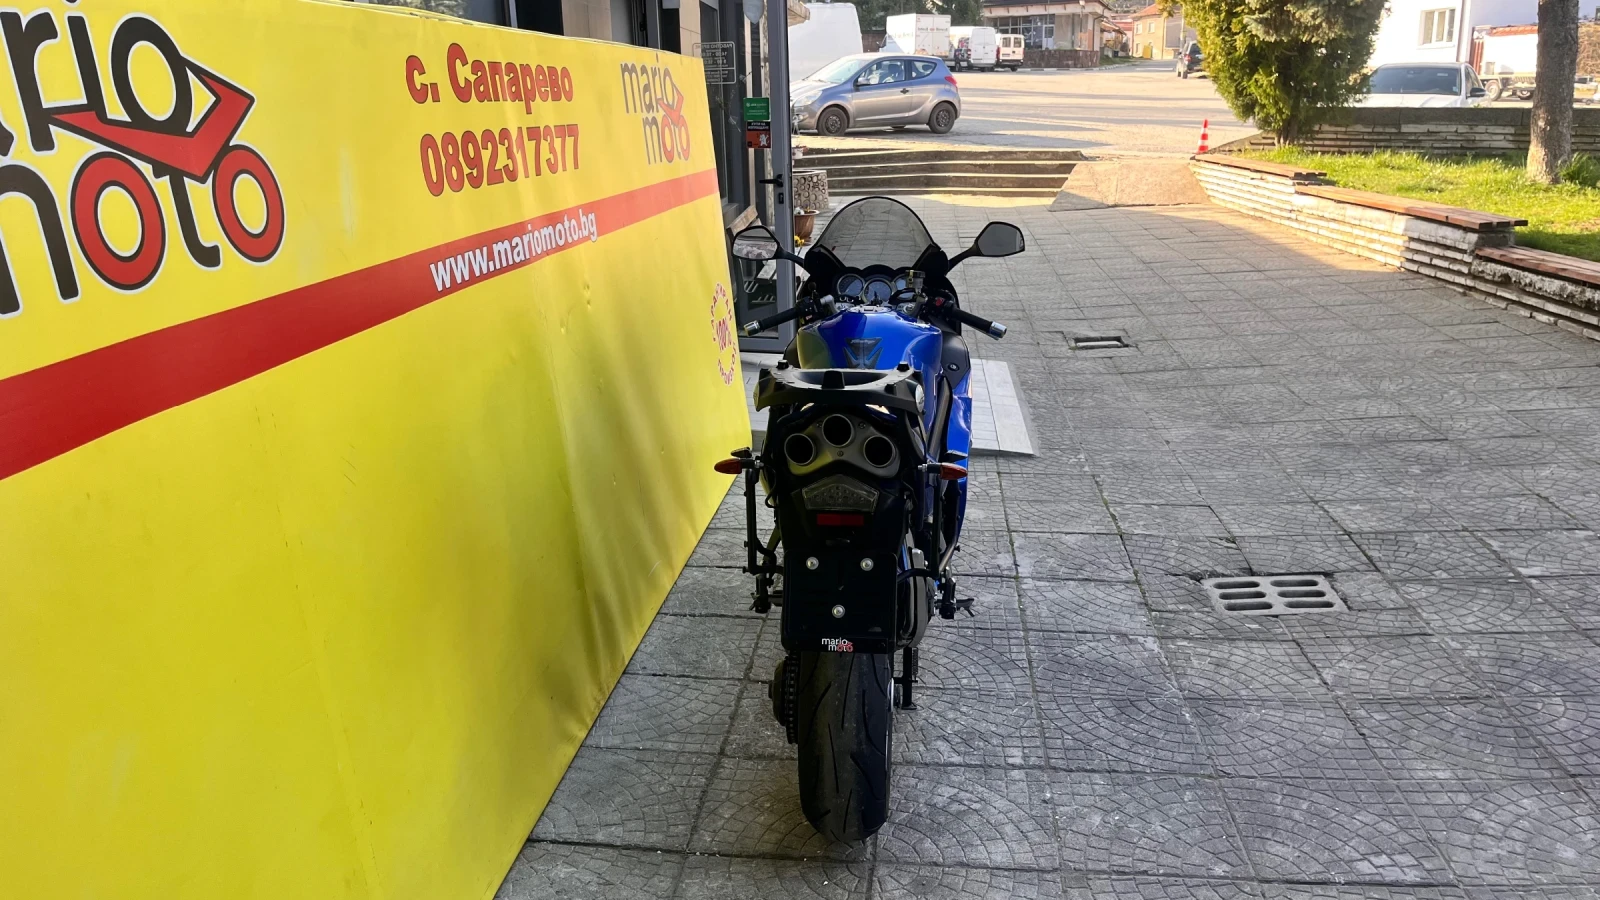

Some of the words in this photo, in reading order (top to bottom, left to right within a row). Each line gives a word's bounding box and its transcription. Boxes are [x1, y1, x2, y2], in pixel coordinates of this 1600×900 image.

[0, 0, 193, 157] rio
[405, 55, 441, 104] с.
[447, 42, 574, 114] Сапарево
[620, 52, 676, 114] mario
[419, 124, 580, 197] 0892317377
[642, 114, 691, 165] moto
[429, 208, 598, 292] www.mariomoto.bg
[821, 637, 848, 645] mario
[828, 644, 854, 652] moto
